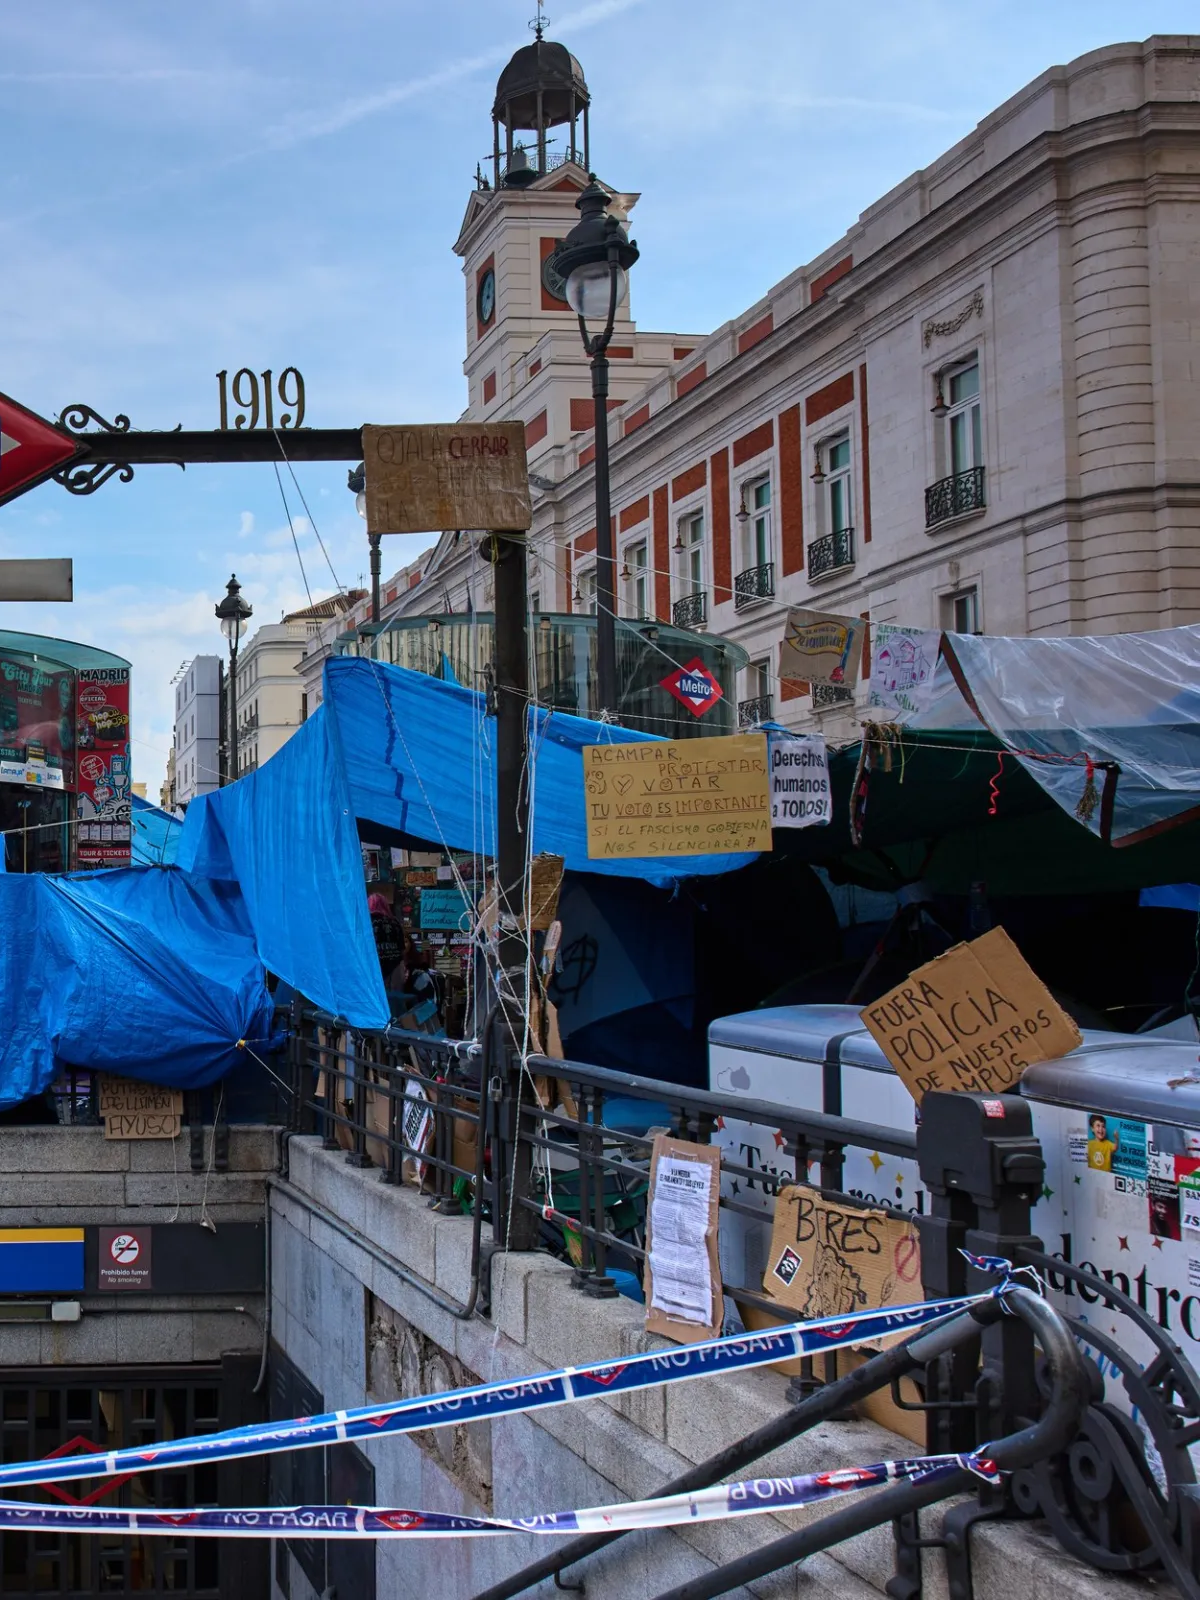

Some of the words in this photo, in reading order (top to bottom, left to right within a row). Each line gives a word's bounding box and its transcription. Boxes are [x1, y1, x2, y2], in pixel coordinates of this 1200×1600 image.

[215, 367, 305, 431] 1919
[448, 434, 509, 460] CERRAR
[1, 662, 30, 682] City
[80, 669, 129, 681] MADRID
[681, 679, 710, 695] Metro
[96, 719, 112, 729] hop
[592, 747, 682, 763] ACAMPAR,
[658, 759, 766, 776] PROTESTAR,
[643, 775, 721, 792] VOTAR
[773, 776, 827, 794] humanos
[591, 803, 610, 817] TU
[615, 802, 653, 816] VOTO
[658, 801, 672, 814] ES
[676, 794, 767, 813] IMPORTANTE
[781, 800, 828, 818] TODOS!
[618, 823, 634, 835] EL
[604, 840, 637, 855] NOS
[869, 980, 943, 1033] FUERA
[915, 1070, 944, 1092] DE
[948, 1009, 1052, 1080] NUESTROS
[109, 1115, 176, 1136] AYUSO
[116, 1276, 142, 1284] smoking
[650, 1351, 691, 1372] NO
[698, 1333, 785, 1362] PASAR
[755, 1477, 795, 1499] NO
[270, 1511, 349, 1527] PASAR
